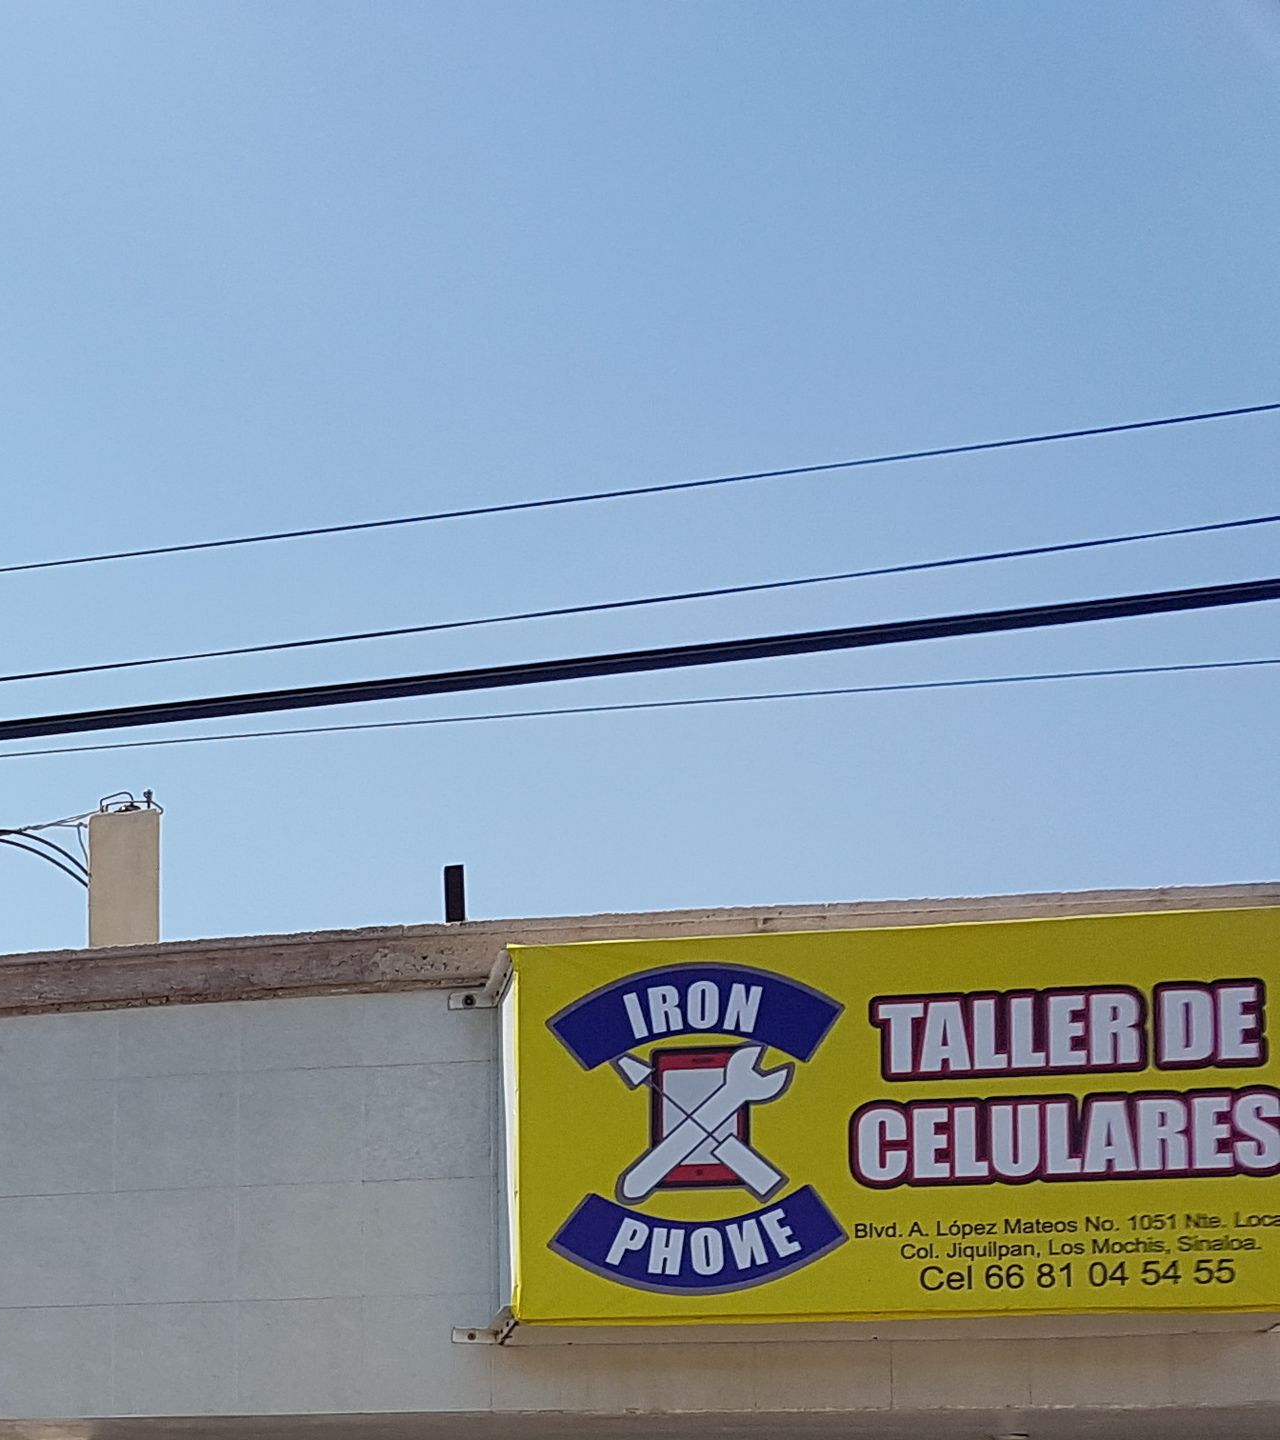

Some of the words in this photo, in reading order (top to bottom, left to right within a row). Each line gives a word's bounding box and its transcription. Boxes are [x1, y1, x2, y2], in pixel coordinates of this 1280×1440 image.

[622, 980, 763, 1039] IRON
[874, 988, 1143, 1078] TALLER
[1157, 982, 1264, 1066] DE
[854, 1090, 1280, 1183] CELULARES
[604, 1207, 802, 1276] PHONE
[854, 1222, 903, 1240] Blvd.
[908, 1221, 929, 1238] A.
[936, 1219, 998, 1240] López
[1003, 1218, 1079, 1236] Mateos
[1084, 1216, 1121, 1232] No.
[1127, 1213, 1178, 1231] 1051
[1185, 1212, 1228, 1230] Nte.
[900, 1243, 940, 1260] Col.
[946, 1241, 1041, 1262] Jiquilpan,
[1048, 1238, 1085, 1256] Los
[1091, 1236, 1171, 1256] Mochis,
[1177, 1233, 1263, 1252] Sinaloa.
[919, 1264, 974, 1292] Cel
[984, 1264, 1025, 1290] 66
[1036, 1262, 1073, 1289] 81
[1088, 1261, 1130, 1288] 04
[1141, 1260, 1183, 1286] 54
[1193, 1258, 1237, 1285] 55
